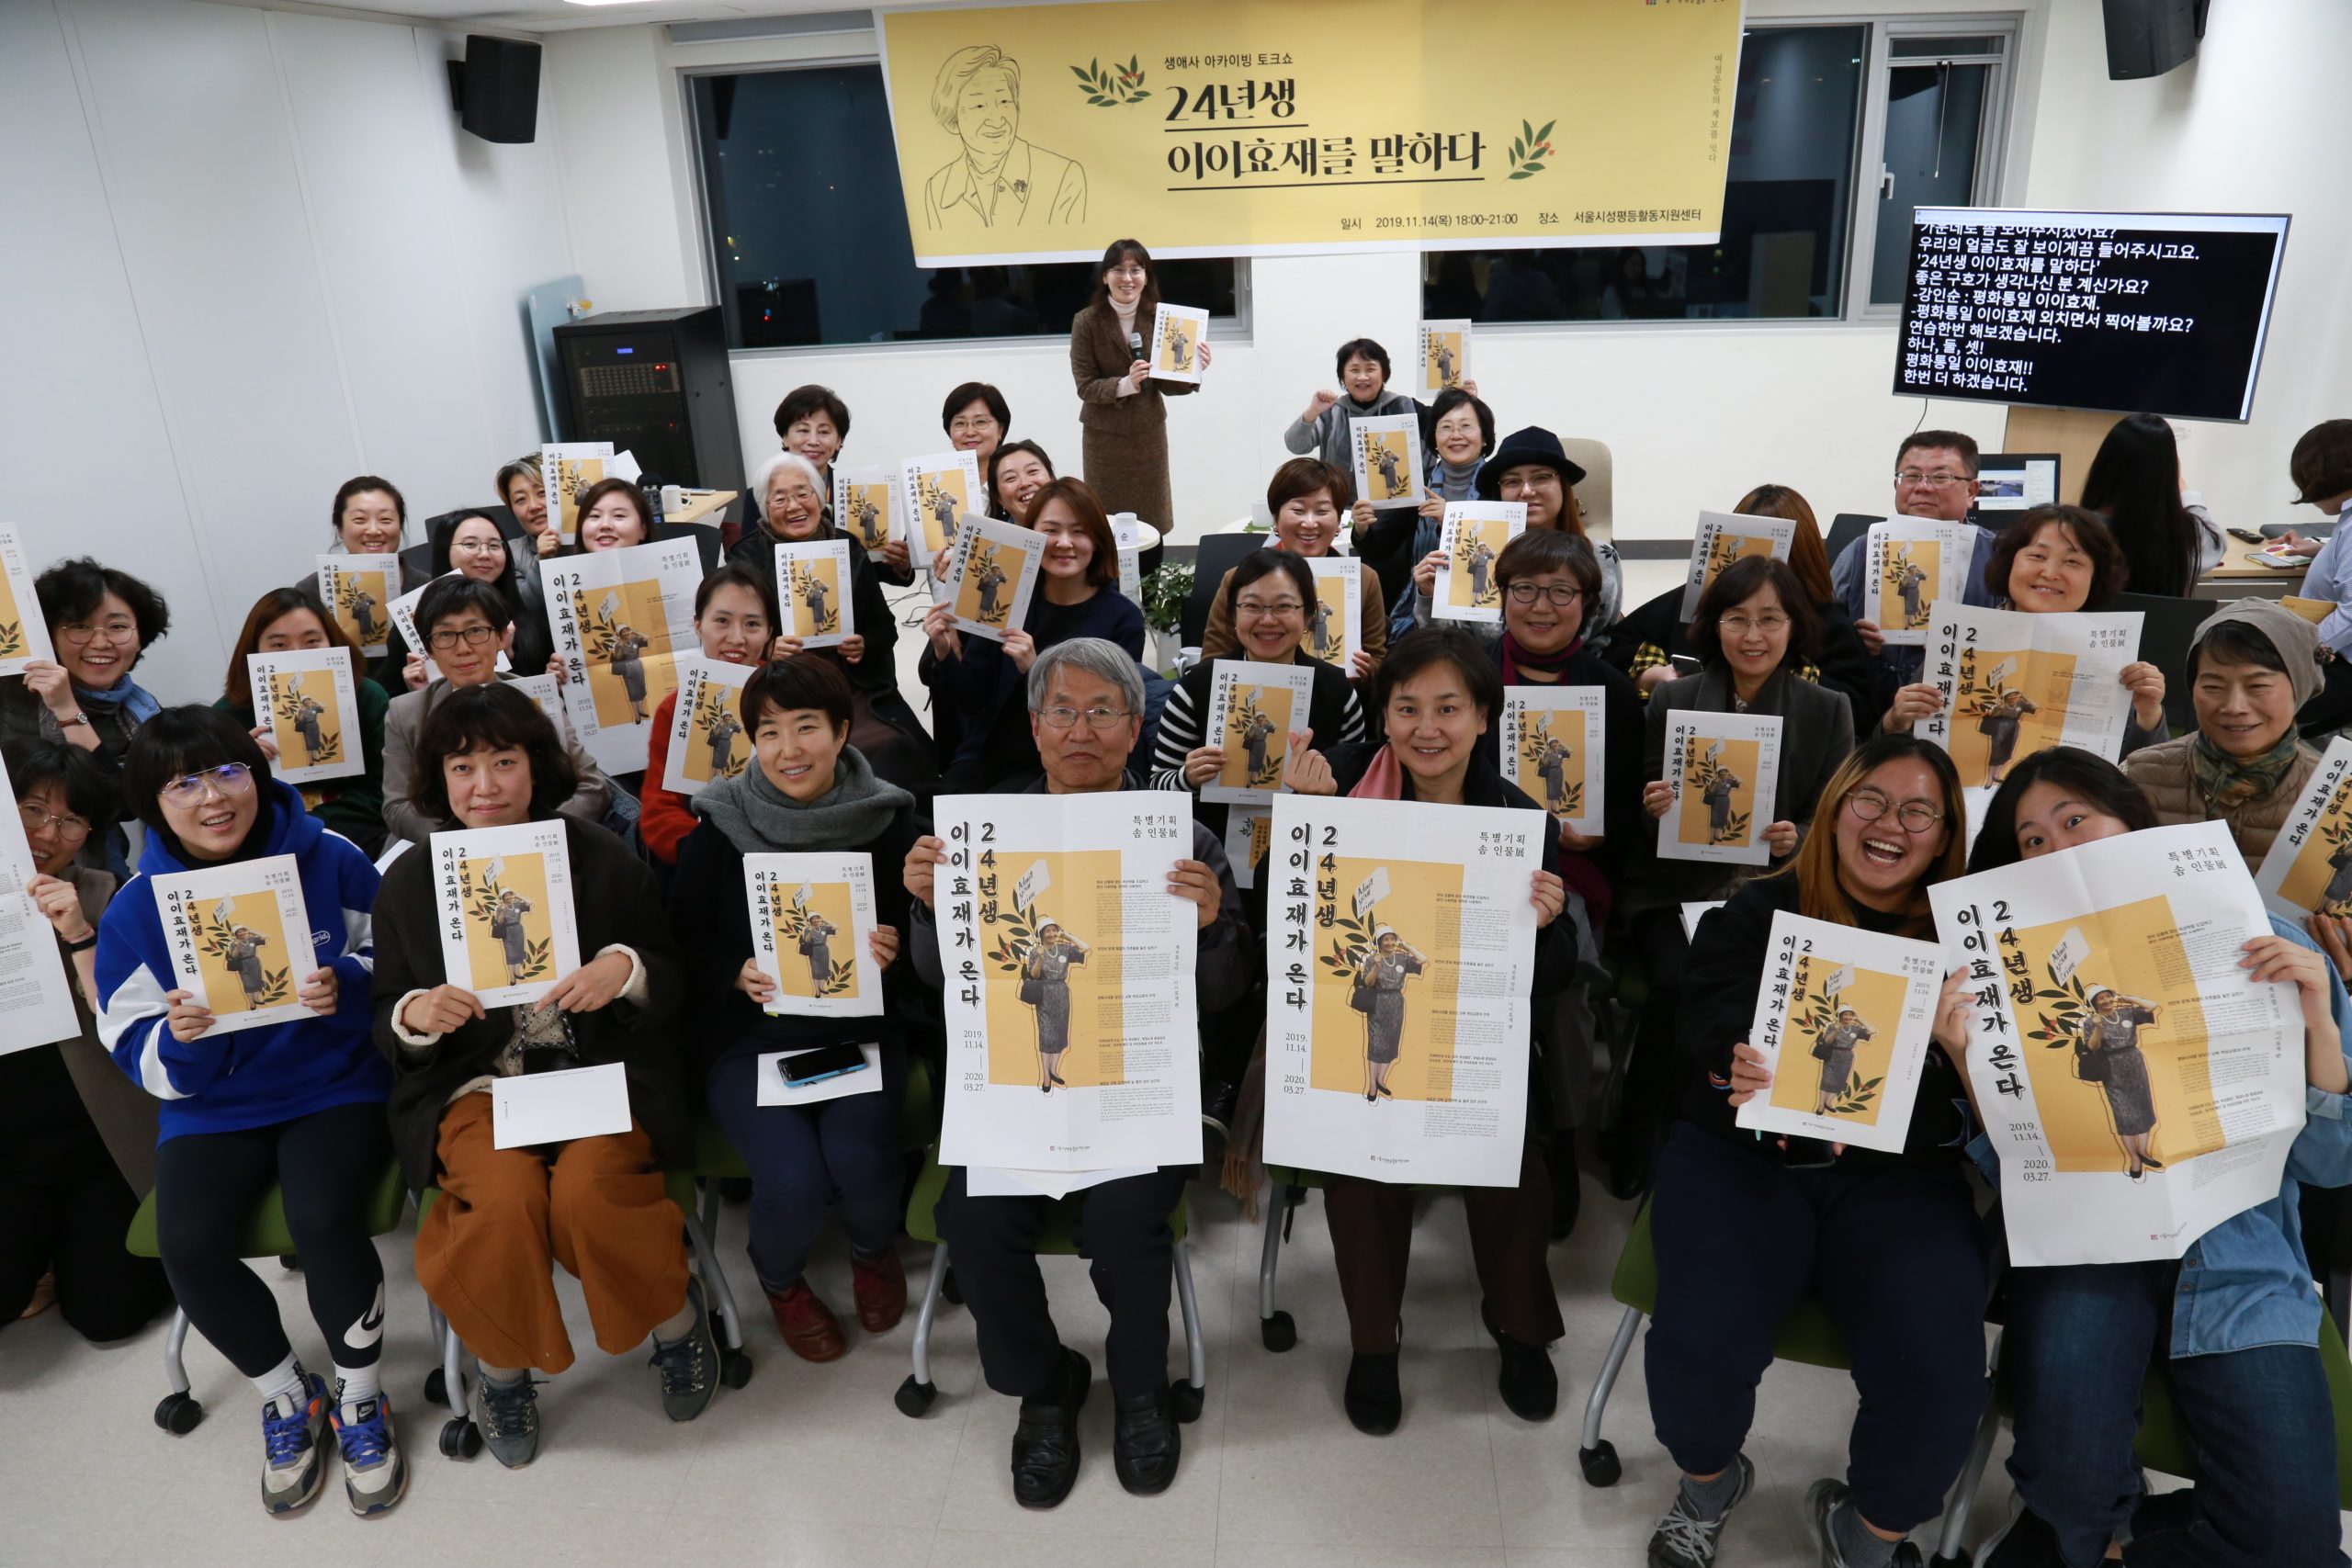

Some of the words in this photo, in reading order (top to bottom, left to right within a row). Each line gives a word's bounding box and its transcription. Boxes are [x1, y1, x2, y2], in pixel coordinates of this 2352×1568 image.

[1164, 56, 1199, 70] 생애사
[1204, 54, 1251, 68] 아카이빙
[1257, 52, 1294, 65] 토크쇼
[1165, 78, 1295, 120] 24년생
[1168, 137, 1357, 180] 이이효재를
[1369, 131, 1486, 174] 말하다
[1340, 218, 1362, 230] 일시
[1375, 215, 1452, 229] 2019.11.14(목)
[1455, 212, 1518, 226] 18:00~21:00
[1539, 211, 1559, 224] 장소
[1574, 209, 1702, 223] 서울시성평등활동지원센터
[1918, 236, 1962, 252] 우리의
[1965, 238, 2008, 254] 얼굴도
[2013, 240, 2029, 254] 잘
[2031, 240, 2094, 257] 보이게끔
[2098, 242, 2199, 260] 들어주시고요.
[1917, 254, 1967, 270] '24년생
[1971, 255, 2045, 273] 이이효재를
[2050, 258, 2100, 276] 말하다'
[1915, 269, 1943, 286] 좋은
[1947, 272, 1990, 288] 구호가
[1994, 274, 2053, 291] 생각나신
[2057, 276, 2073, 292] 분
[2077, 276, 2149, 294] 계신가요?
[1913, 288, 1961, 304] -강인순
[1973, 289, 2031, 308] 평화통일
[2035, 292, 2100, 310] 이이효재.
[1909, 321, 1965, 337] 연습한번
[1969, 323, 2062, 344] 해보겠습니다.
[1911, 304, 1973, 321] -평화통일
[1977, 307, 2036, 324] 이이효재
[2040, 310, 2100, 329] 외치면서
[2105, 313, 2194, 333] 찍어볼까요?
[1907, 336, 1939, 354] 하나,
[1942, 338, 1961, 355] 둘,
[1965, 340, 1984, 355] 셋!
[1905, 353, 1962, 370] 평화통일
[1965, 356, 2033, 375] 이이효재!!
[1904, 369, 1930, 384] 한번
[1935, 371, 1949, 386] 더
[1952, 372, 2028, 392] 하겠습니다.
[571, 573, 593, 634] 24년생
[553, 574, 579, 652] 이이효재가
[568, 658, 585, 686] 온다
[1957, 627, 1978, 694] 24년생
[256, 665, 271, 714] 이이효재가
[269, 664, 280, 703] 24년생
[1215, 672, 1228, 724] 이이효재가
[1227, 673, 1238, 714] 24년생
[1213, 726, 1223, 747] 온다
[1507, 700, 1516, 753] 이이효재가
[1518, 700, 1527, 742] 24년생
[1672, 725, 1685, 776] 이이효재가
[1685, 726, 1697, 768] 24년생
[1507, 756, 1517, 777] 온다
[2303, 759, 2347, 819] 이이효재가
[2327, 772, 2352, 815] 4년생
[1133, 815, 1177, 826] 특별기획
[2290, 824, 2309, 846] 온다
[1478, 831, 1525, 844] 특별기획
[2168, 846, 2222, 862] 특별기획
[442, 848, 460, 912] 이이효재가
[458, 847, 472, 897] 24년생
[950, 821, 976, 950] 이이효재가
[978, 822, 1000, 925] 24년생
[1315, 826, 1338, 929] 24년생
[754, 871, 772, 927] 이이효재가
[770, 872, 783, 916] 24년생
[1285, 823, 1313, 954] 이이효재가
[184, 890, 203, 936] 24년생
[167, 891, 191, 950] 이이효재가
[182, 953, 198, 976] 온다
[449, 918, 463, 942] 온다
[762, 931, 774, 953] 온다
[1992, 900, 2036, 1005] 24년생
[958, 959, 981, 1010] 온다
[1770, 935, 1797, 1012] 이이효재가
[1792, 939, 1814, 1002] 24년생
[1285, 962, 1308, 1012] 온다
[1957, 904, 2010, 1034] 이이효재가
[1988, 1044, 2026, 1101] 온다
[963, 1030, 984, 1038] 2019.
[965, 1040, 985, 1049] 11.14.
[1285, 1032, 1308, 1043] 2019.
[1285, 1043, 1308, 1053] 11.14.
[1763, 1017, 1781, 1048] 온다
[964, 1073, 985, 1081] 2020.
[964, 1083, 985, 1091] 03.27.
[1283, 1086, 1306, 1096] 03.27.
[1284, 1075, 1306, 1085] 2020.
[2008, 1122, 2039, 1133] 2019.
[2013, 1132, 2041, 1142] 11.14.
[2023, 1159, 2052, 1169] 2020.
[2023, 1172, 2052, 1182] 03.27.
